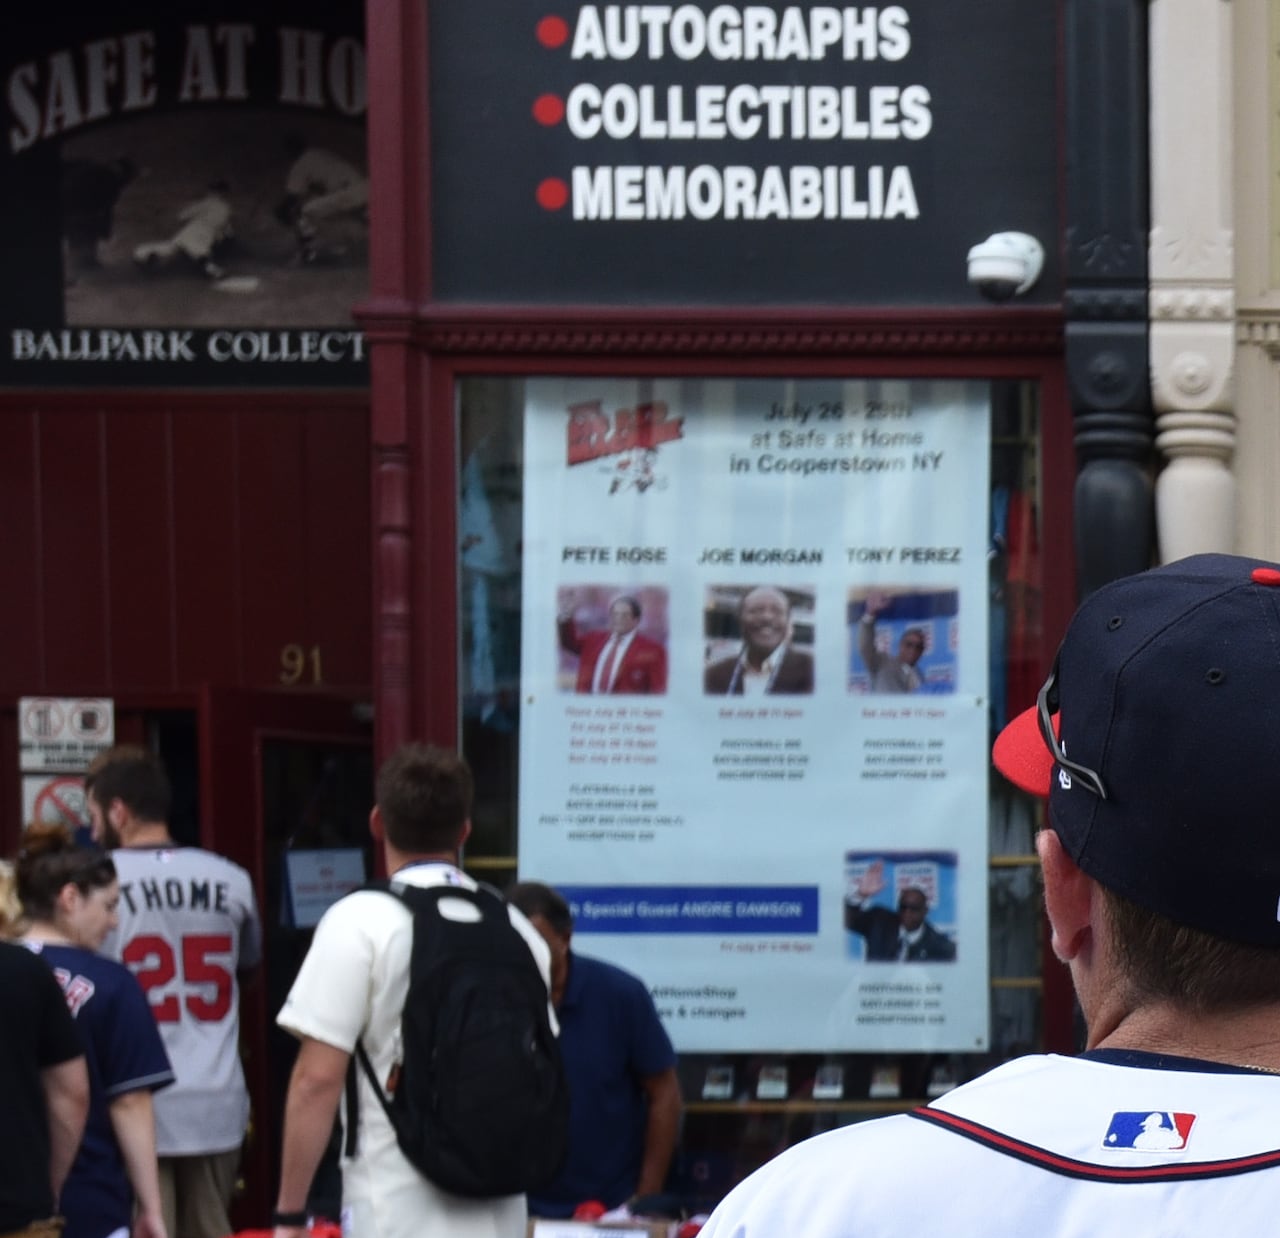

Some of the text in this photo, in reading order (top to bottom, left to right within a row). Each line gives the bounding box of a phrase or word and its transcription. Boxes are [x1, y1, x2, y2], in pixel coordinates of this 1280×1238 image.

[571, 5, 911, 61] AUTOGRAPHS
[7, 31, 157, 154] SAFE
[180, 24, 257, 101] AT
[566, 83, 933, 141] COLLECTIBLES
[572, 165, 919, 220] MEMORABILIA
[12, 330, 365, 363] BALLPARK COLLECT
[765, 401, 812, 425] July
[751, 429, 924, 449] at Safe at Home
[729, 451, 943, 477] in Cooperstown NY
[562, 547, 668, 564] PETE ROSE
[698, 548, 824, 565] JOE MORGAN
[846, 547, 962, 564] TONY PEREZ
[279, 644, 323, 686] 91
[122, 878, 231, 917] THOME
[583, 901, 634, 920] Special
[637, 901, 679, 919] Guest
[681, 902, 732, 918] ANDRE
[736, 902, 803, 918] DAWSON
[122, 933, 235, 1024] 25
